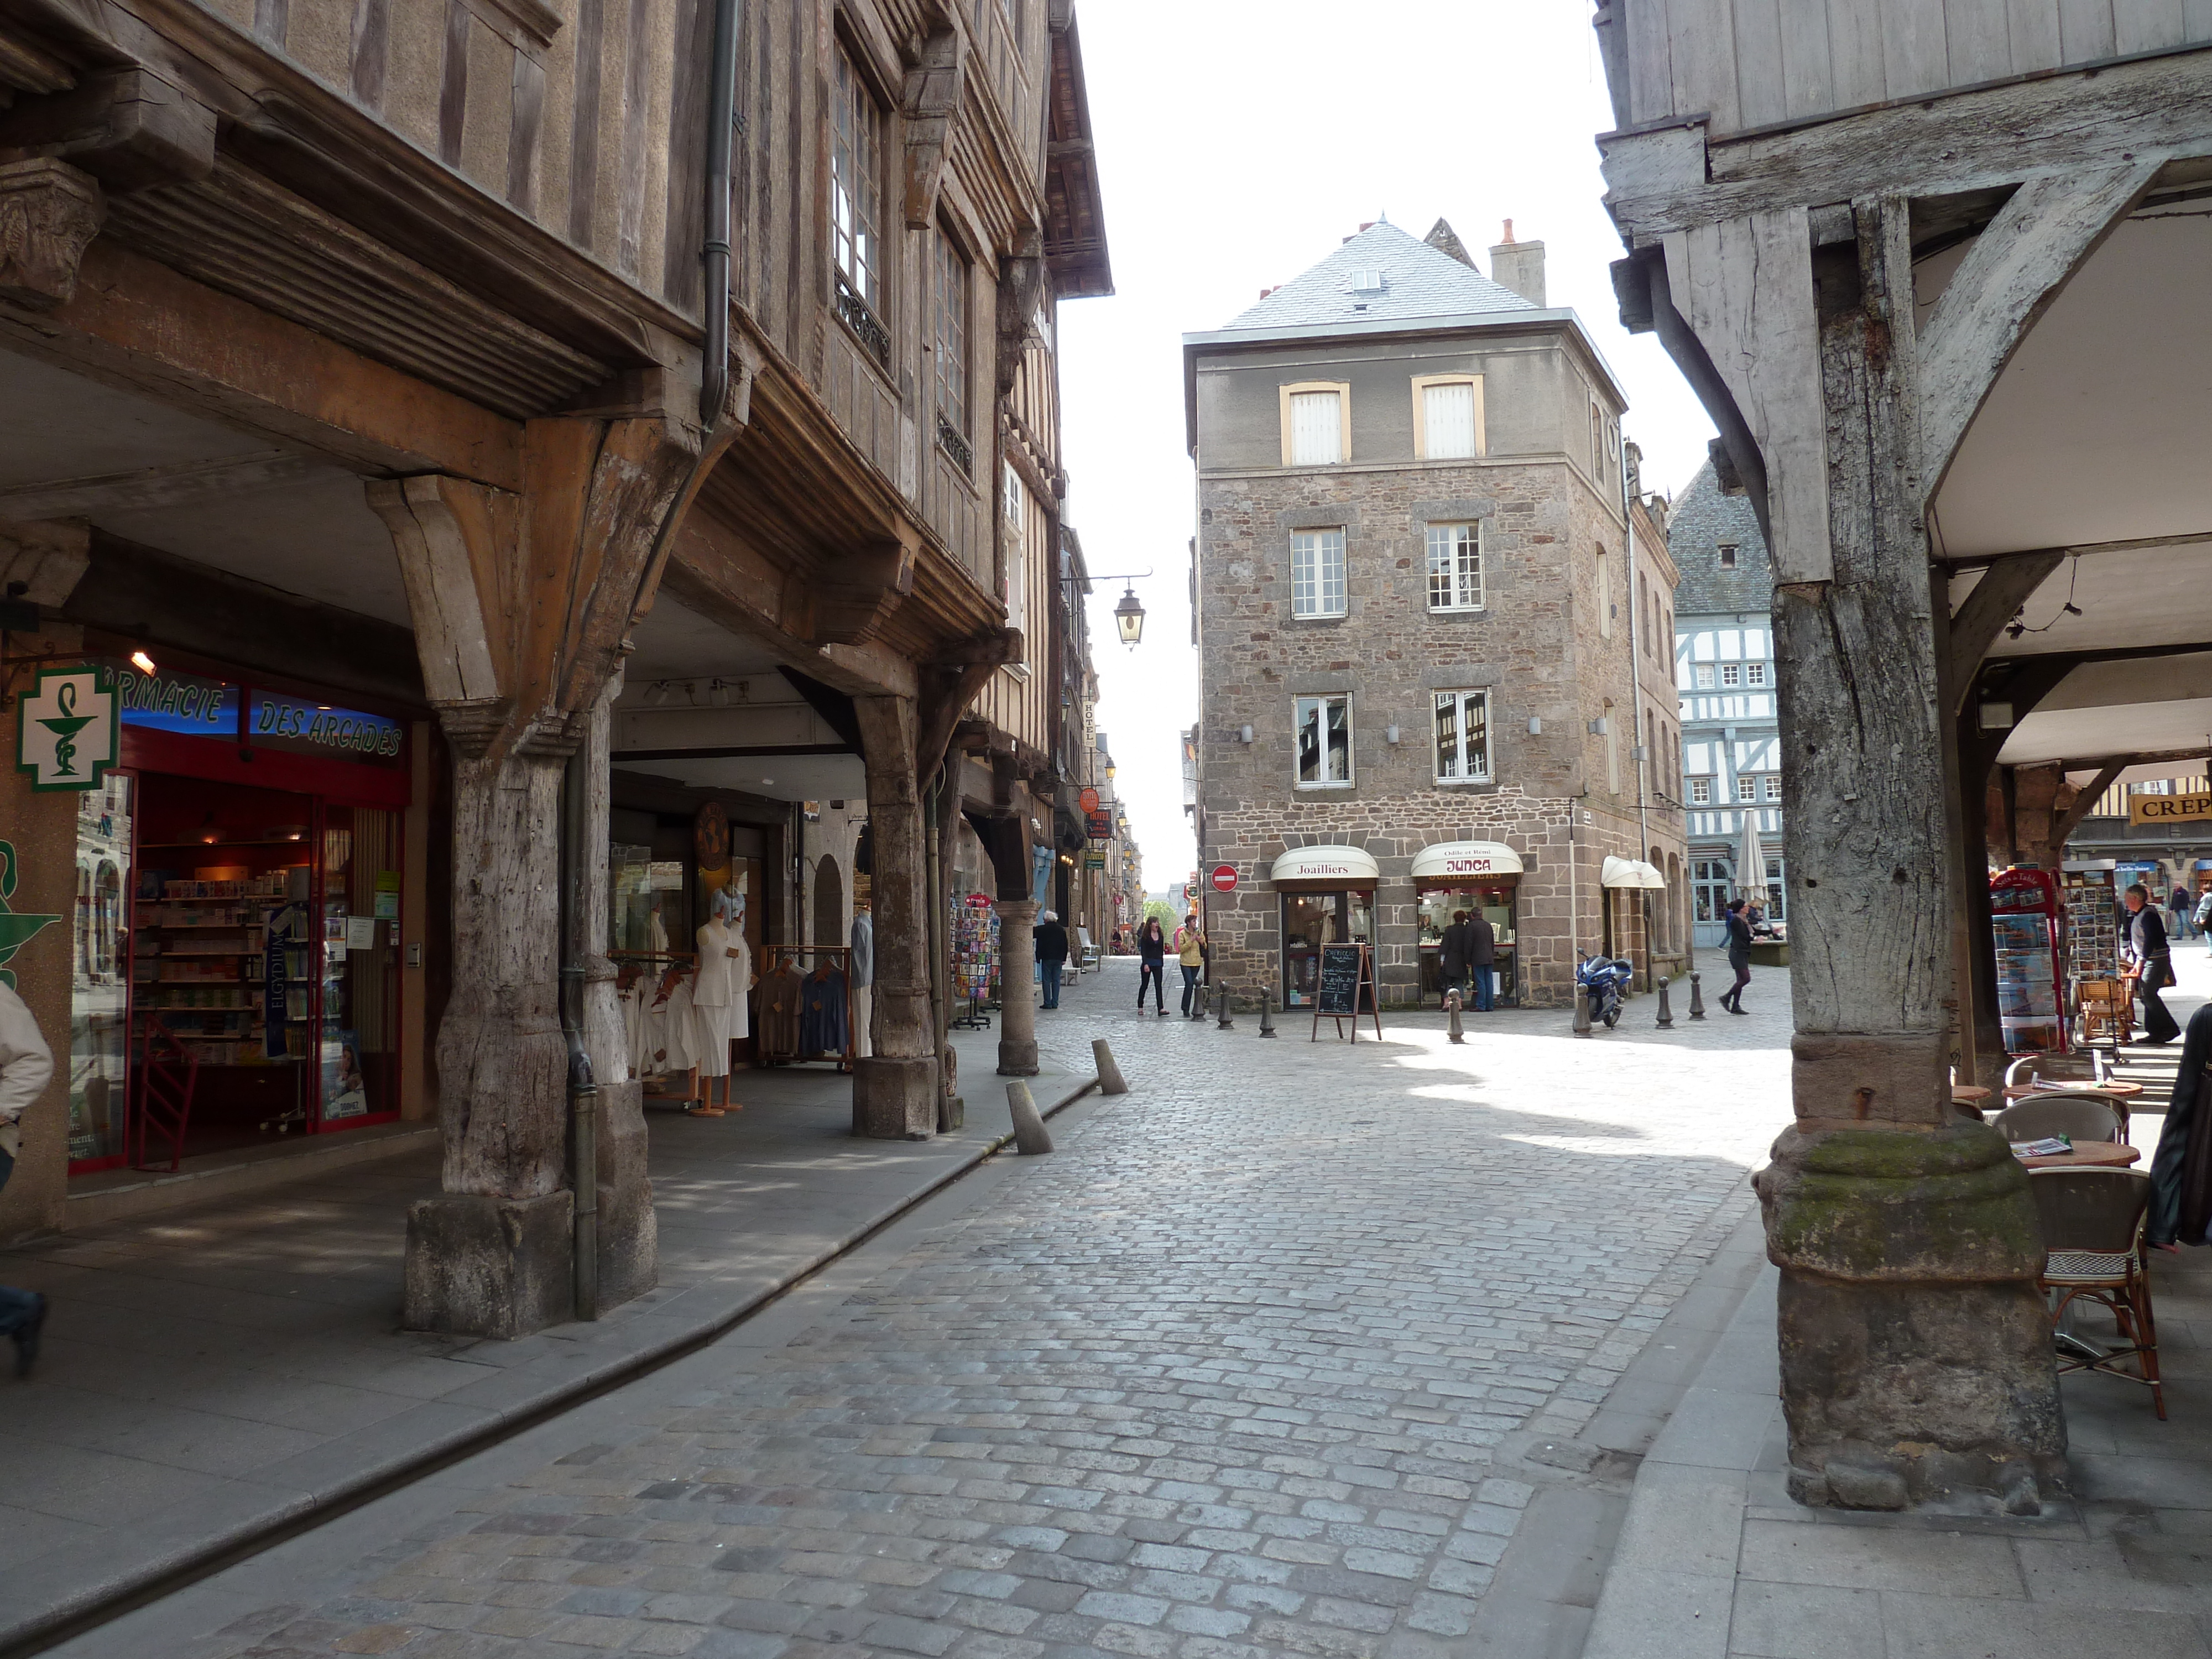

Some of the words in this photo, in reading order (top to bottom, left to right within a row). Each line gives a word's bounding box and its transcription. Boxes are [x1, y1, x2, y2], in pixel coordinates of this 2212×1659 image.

[258, 701, 304, 739] DES
[307, 713, 403, 757] ARCADES
[1085, 705, 1094, 740] HOTEL
[1089, 812, 1110, 821] HOTEL
[1297, 864, 1349, 874] Joailliers
[1446, 859, 1491, 872] JUNCA
[1995, 877, 2011, 888] Sets
[2017, 873, 2038, 885] Table
[271, 933, 284, 1009] ELGYDIUM
